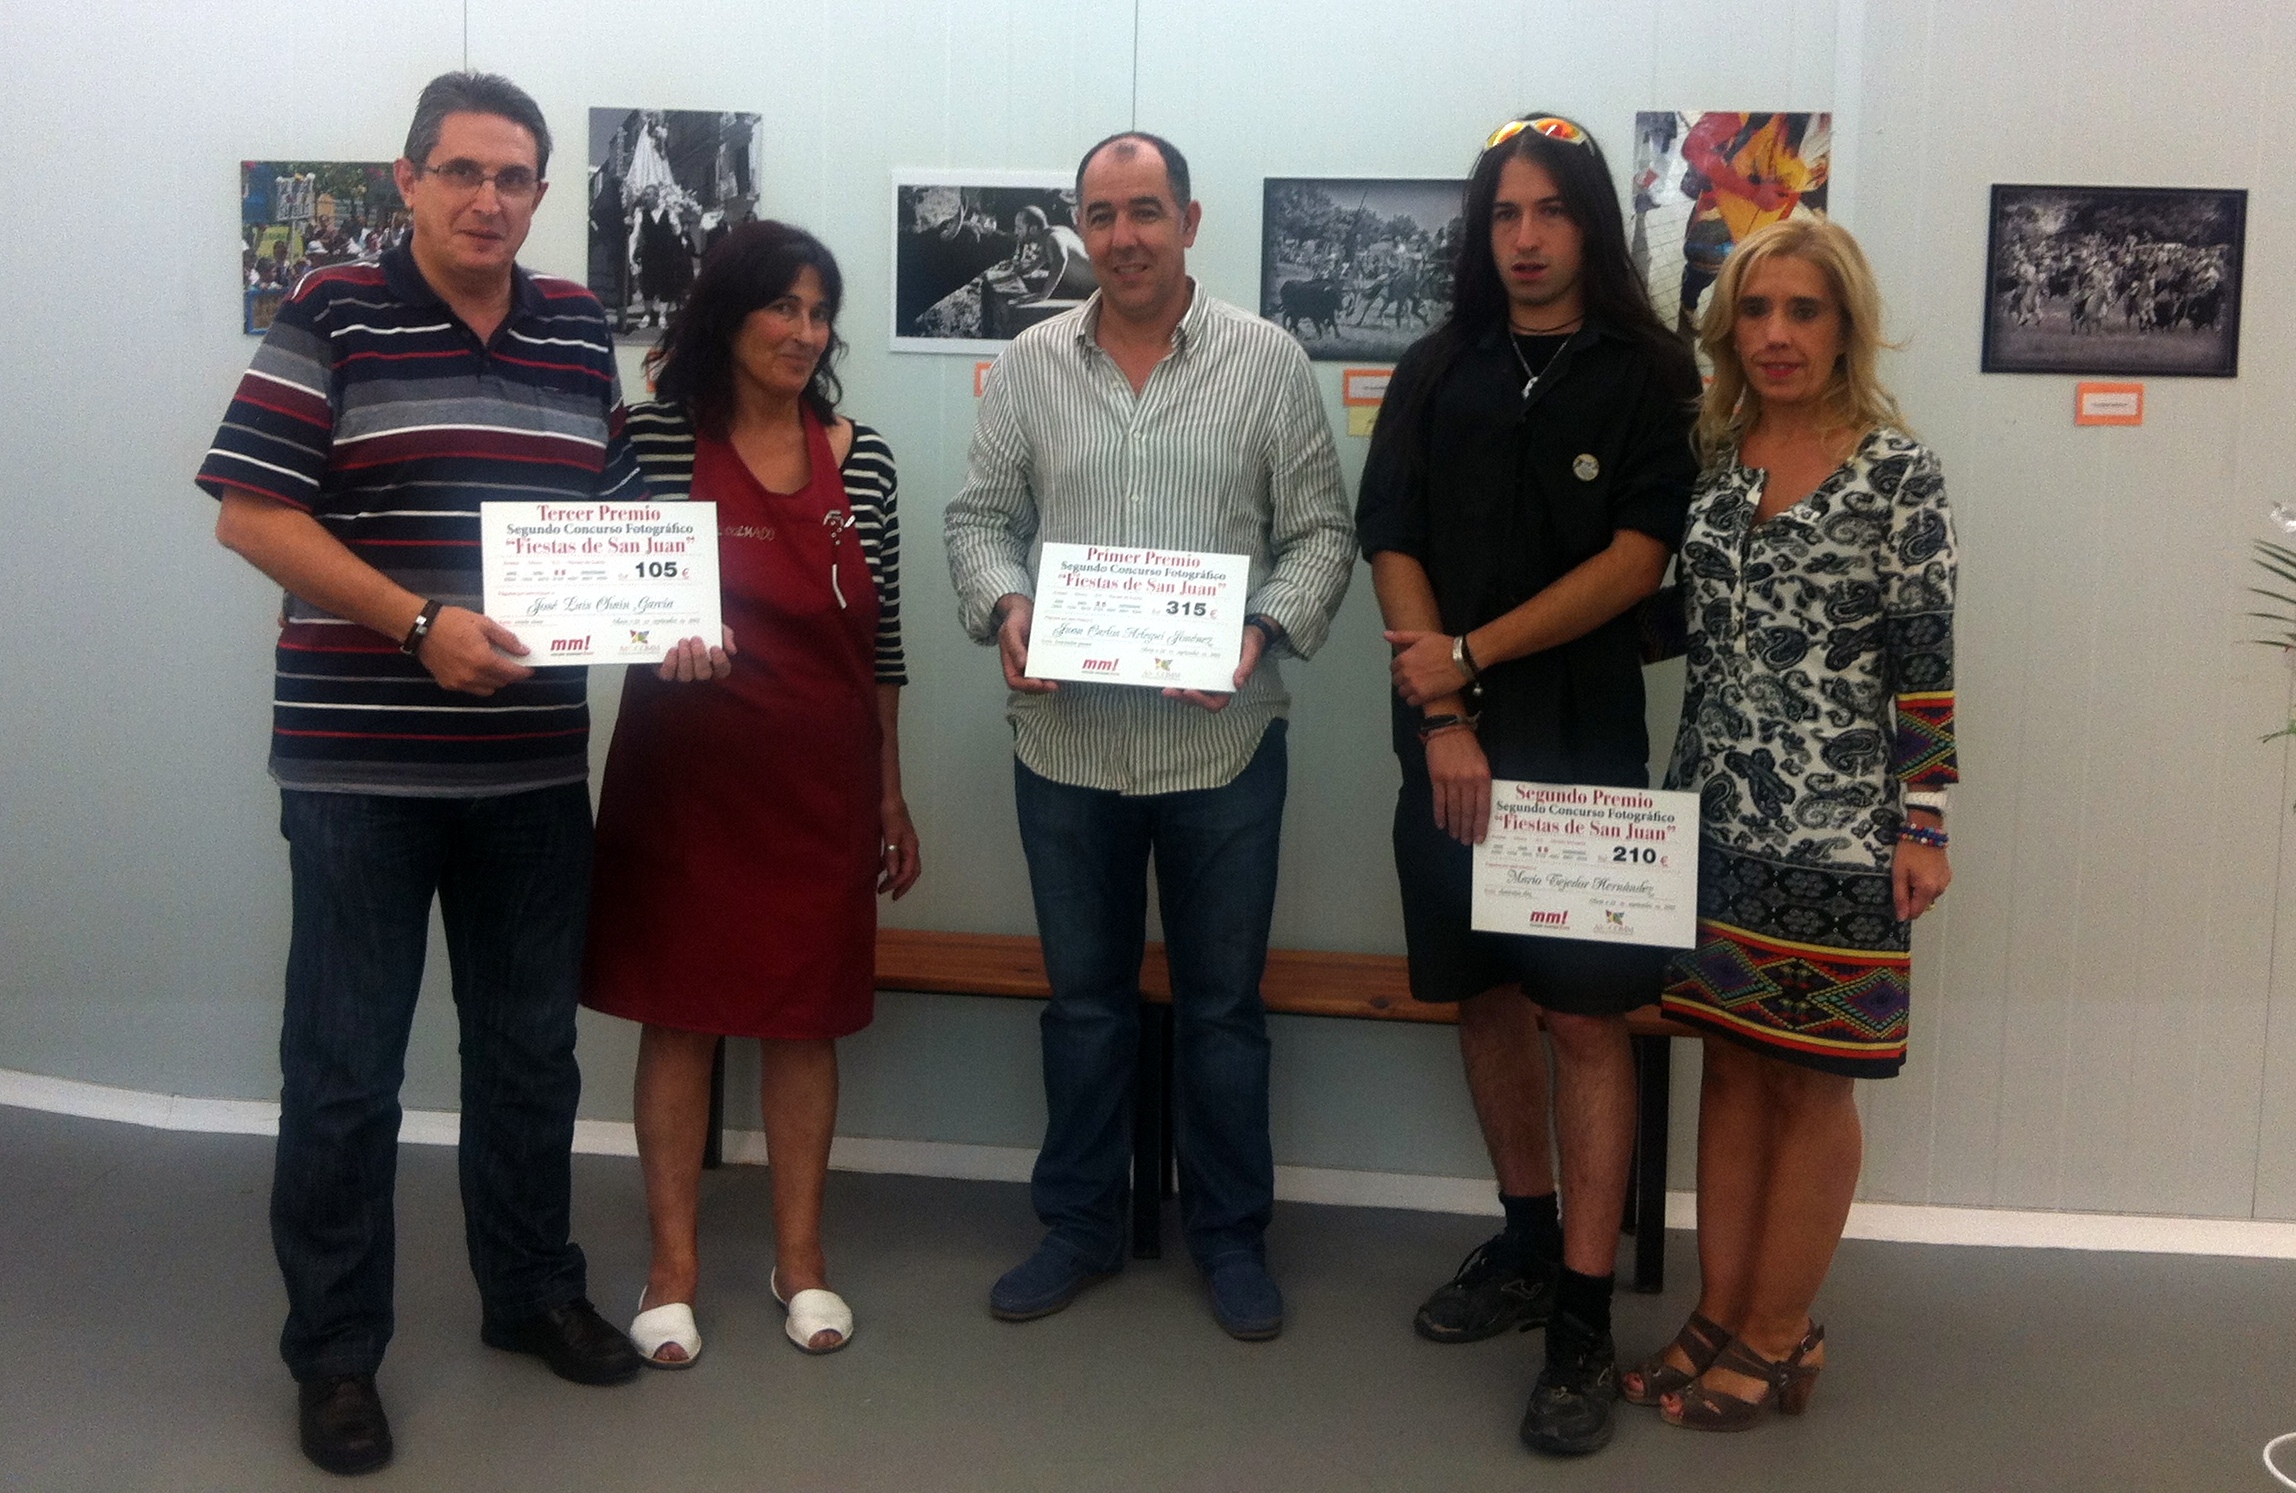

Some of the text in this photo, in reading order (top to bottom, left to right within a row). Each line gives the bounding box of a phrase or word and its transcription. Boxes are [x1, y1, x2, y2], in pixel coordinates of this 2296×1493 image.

[537, 504, 661, 521] Tercer Premio
[507, 522, 694, 537] Segundo Concurso Fotográfico
[582, 538, 603, 553] de
[608, 537, 640, 553] San
[1086, 547, 1200, 568] Primer Premio
[635, 561, 678, 579] 105
[682, 567, 690, 580] €
[1061, 561, 1226, 581] Segundo Concurso Fotográfico
[1123, 577, 1142, 590] de
[1146, 577, 1174, 593] San
[1166, 600, 1207, 617] 315
[1210, 608, 1218, 619] €
[550, 635, 591, 651] mm!
[1082, 658, 1119, 671] mm!
[1515, 784, 1653, 808] Segundo Premio
[1496, 801, 1675, 823] Segundo Concurso Fotográfico
[1565, 819, 1585, 834] de
[1590, 820, 1621, 838] San
[1613, 846, 1657, 864] 210
[1660, 856, 1669, 867] €
[1530, 910, 1569, 925] mm!
